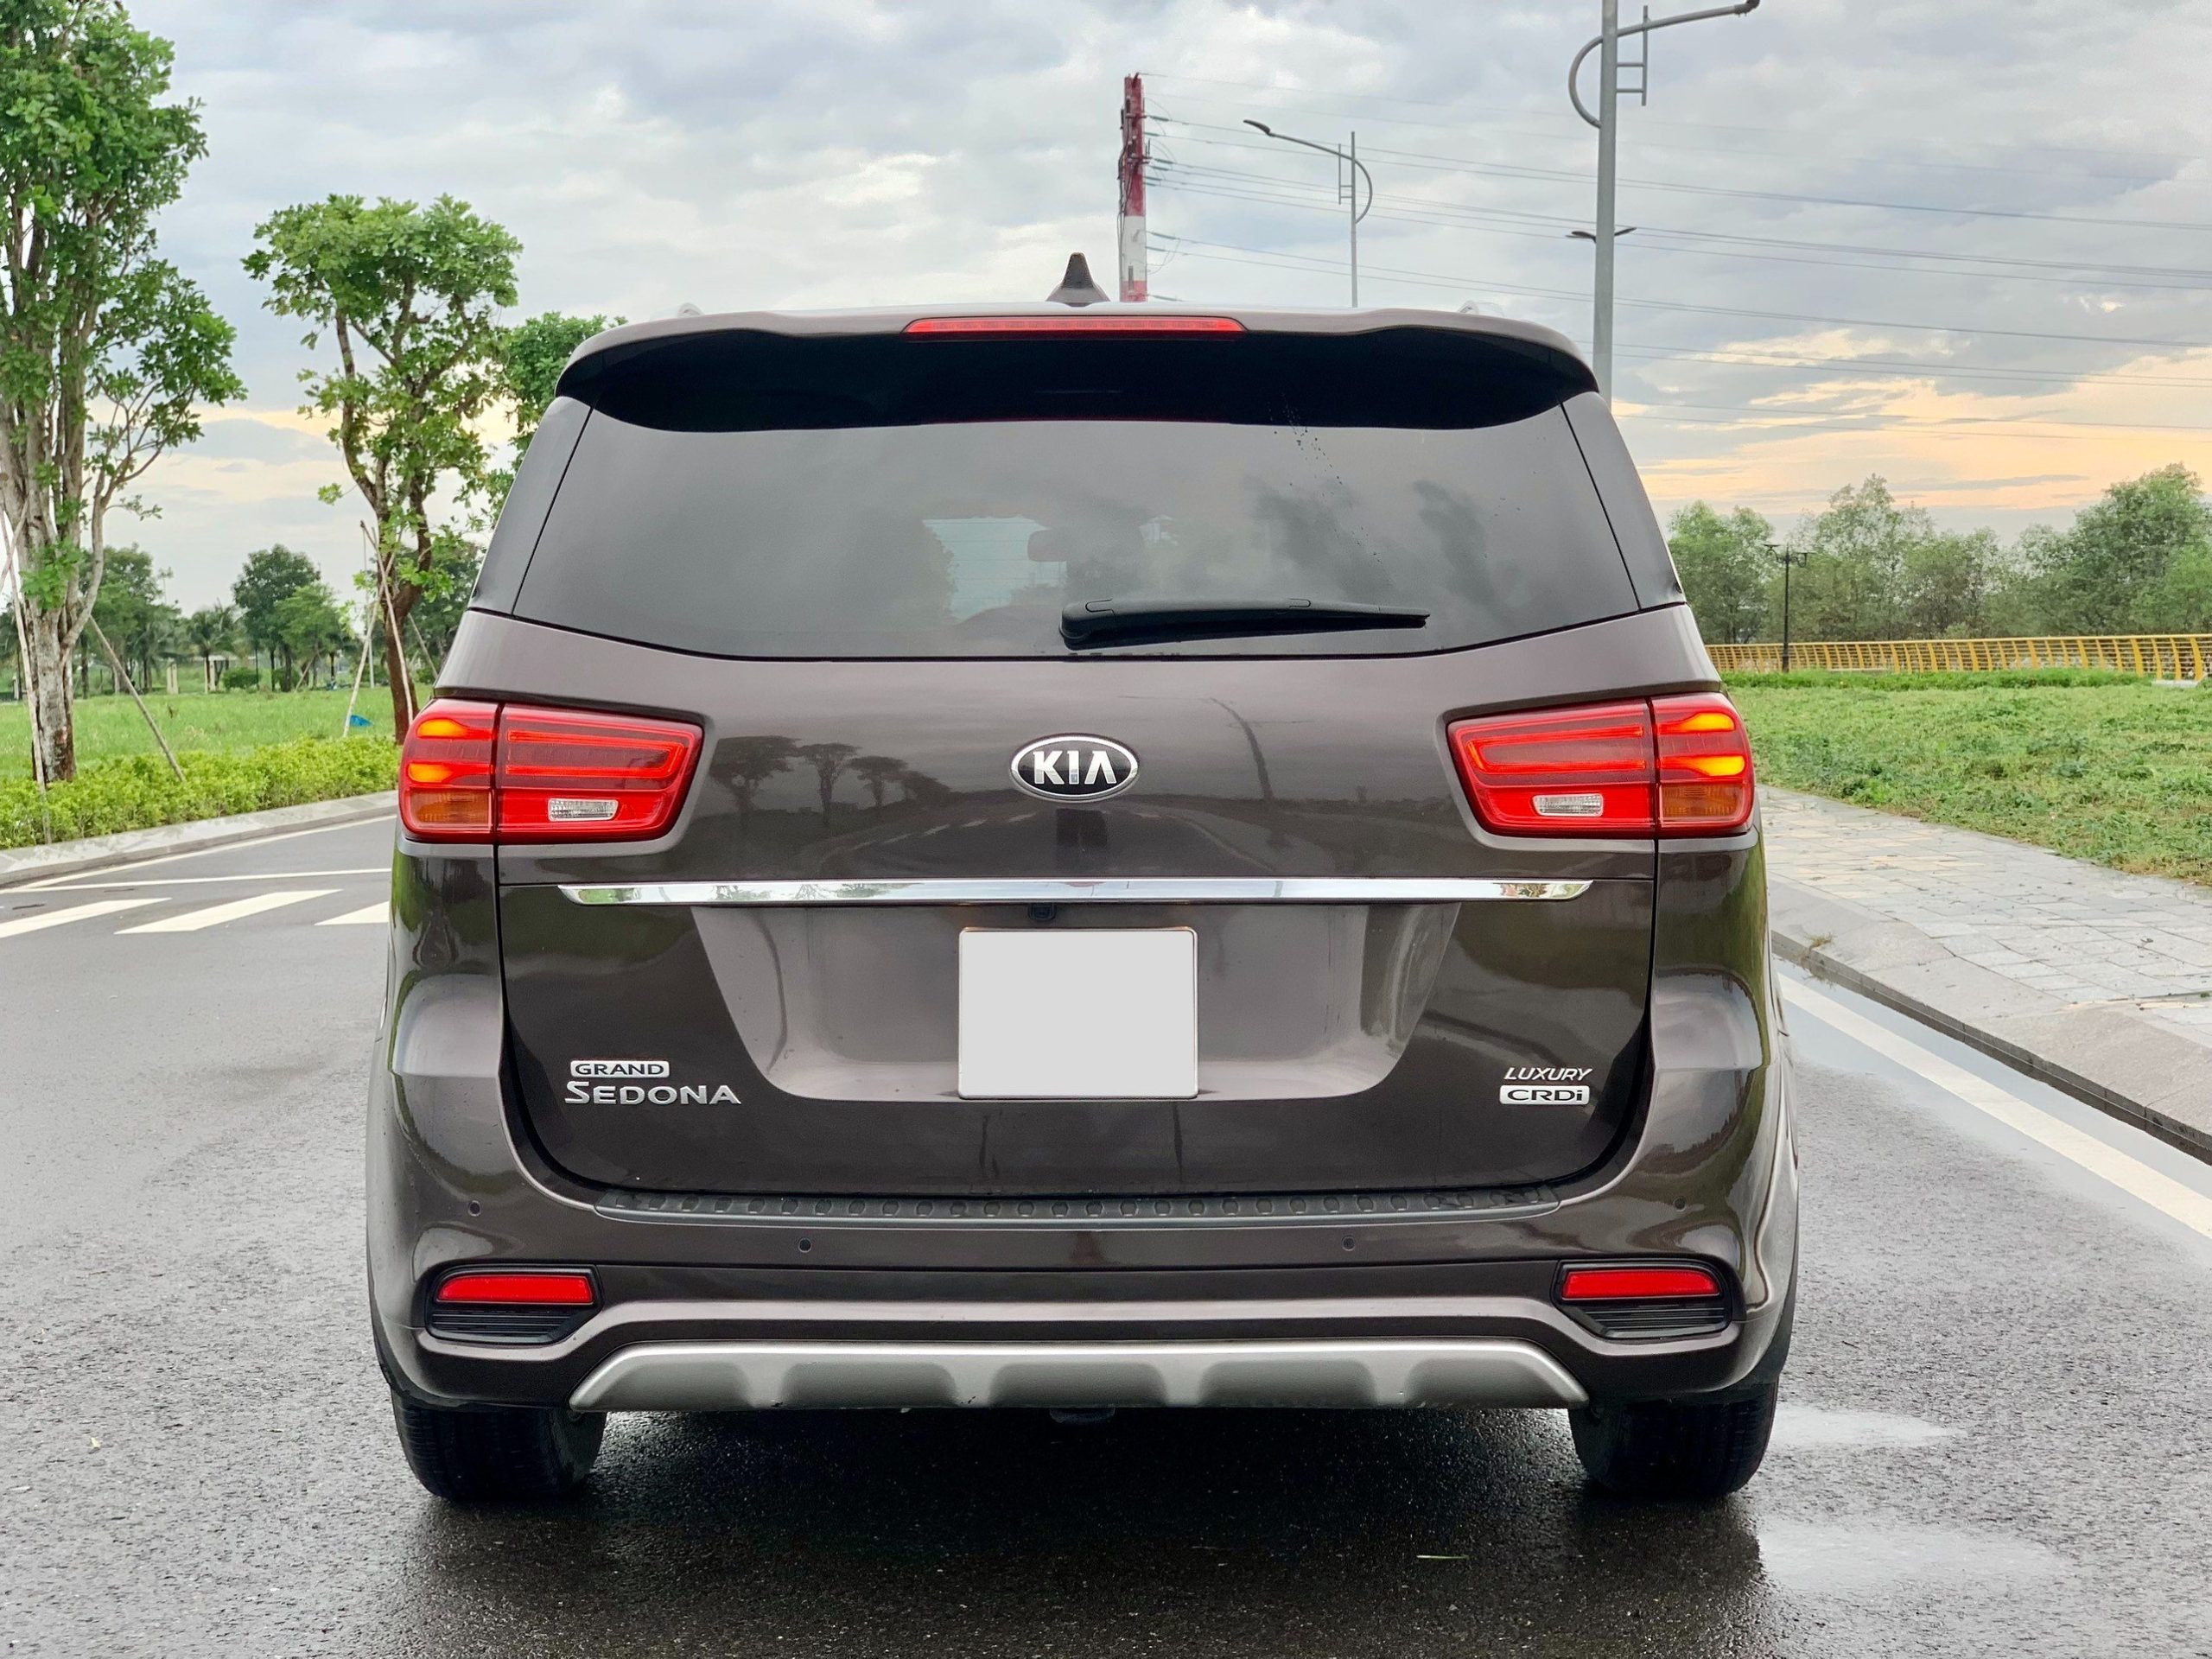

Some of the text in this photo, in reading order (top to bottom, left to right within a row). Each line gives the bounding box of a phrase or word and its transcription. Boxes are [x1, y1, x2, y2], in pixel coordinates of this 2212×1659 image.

[1033, 750, 1117, 785] KIA
[574, 1063, 665, 1076] GRAND
[1503, 1067, 1593, 1081] LUXURY
[564, 1080, 742, 1105] SEDONA
[1507, 1089, 1584, 1102] CRDi
